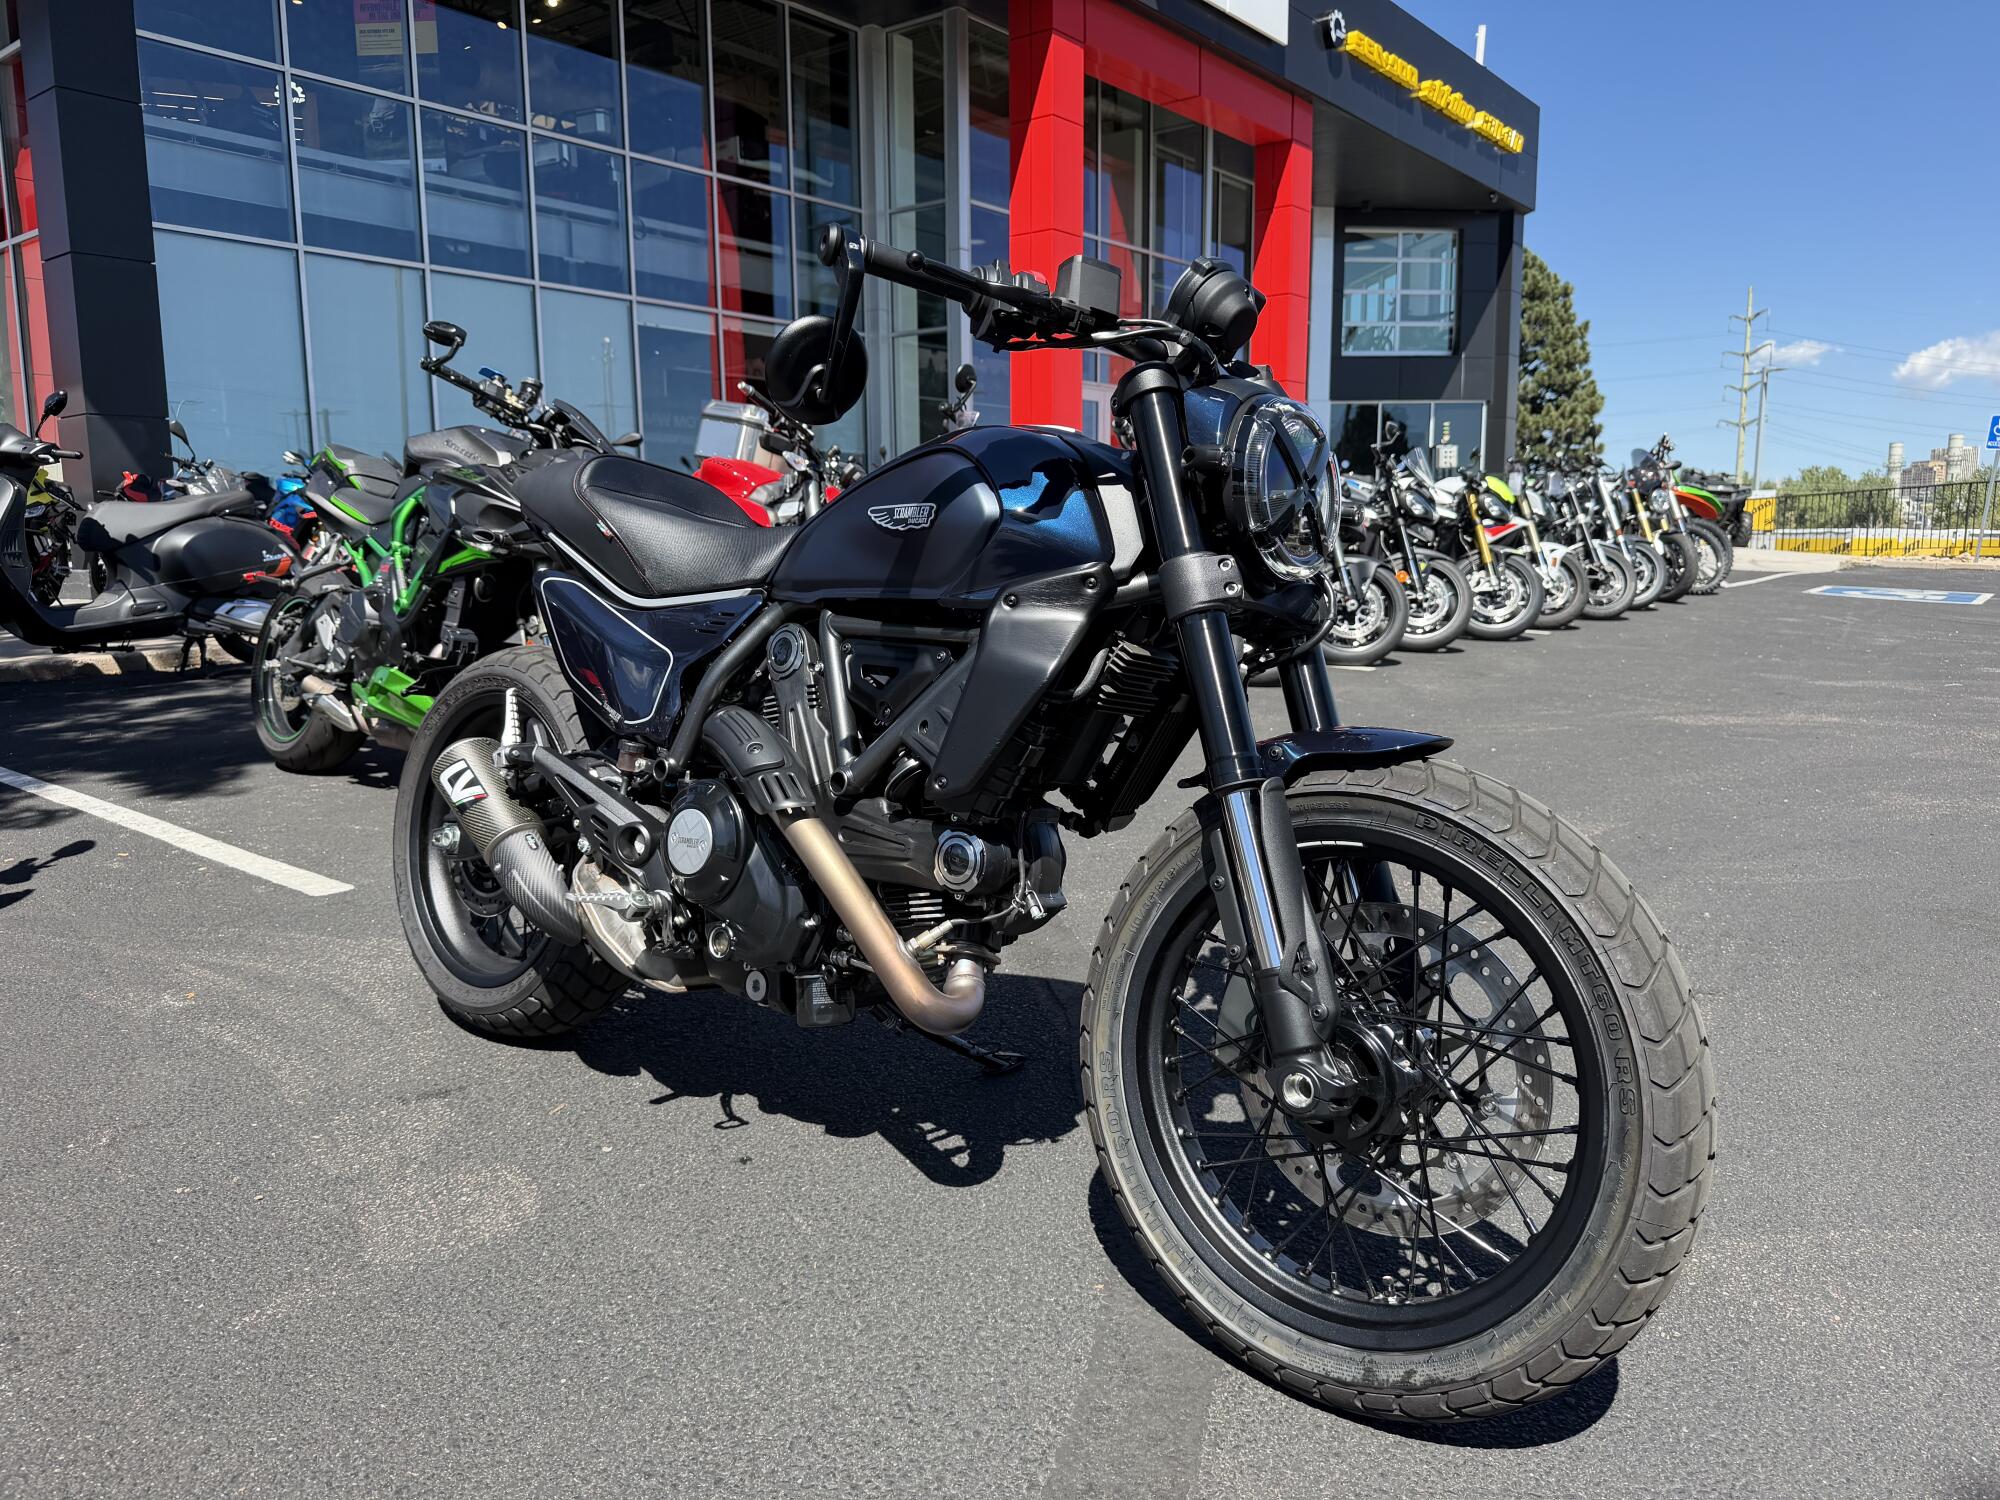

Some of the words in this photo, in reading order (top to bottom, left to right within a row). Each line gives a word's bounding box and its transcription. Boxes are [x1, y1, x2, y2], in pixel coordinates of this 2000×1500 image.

[893, 507, 930, 519] SCRAMBLER
[1415, 813, 1558, 920] PIRELLI
[1559, 927, 1624, 1040] MT60
[1614, 1058, 1637, 1115] RS
[1100, 1051, 1116, 1098] RS
[1107, 1111, 1155, 1210] MT60
[1149, 1216, 1261, 1337] PIRELLI
